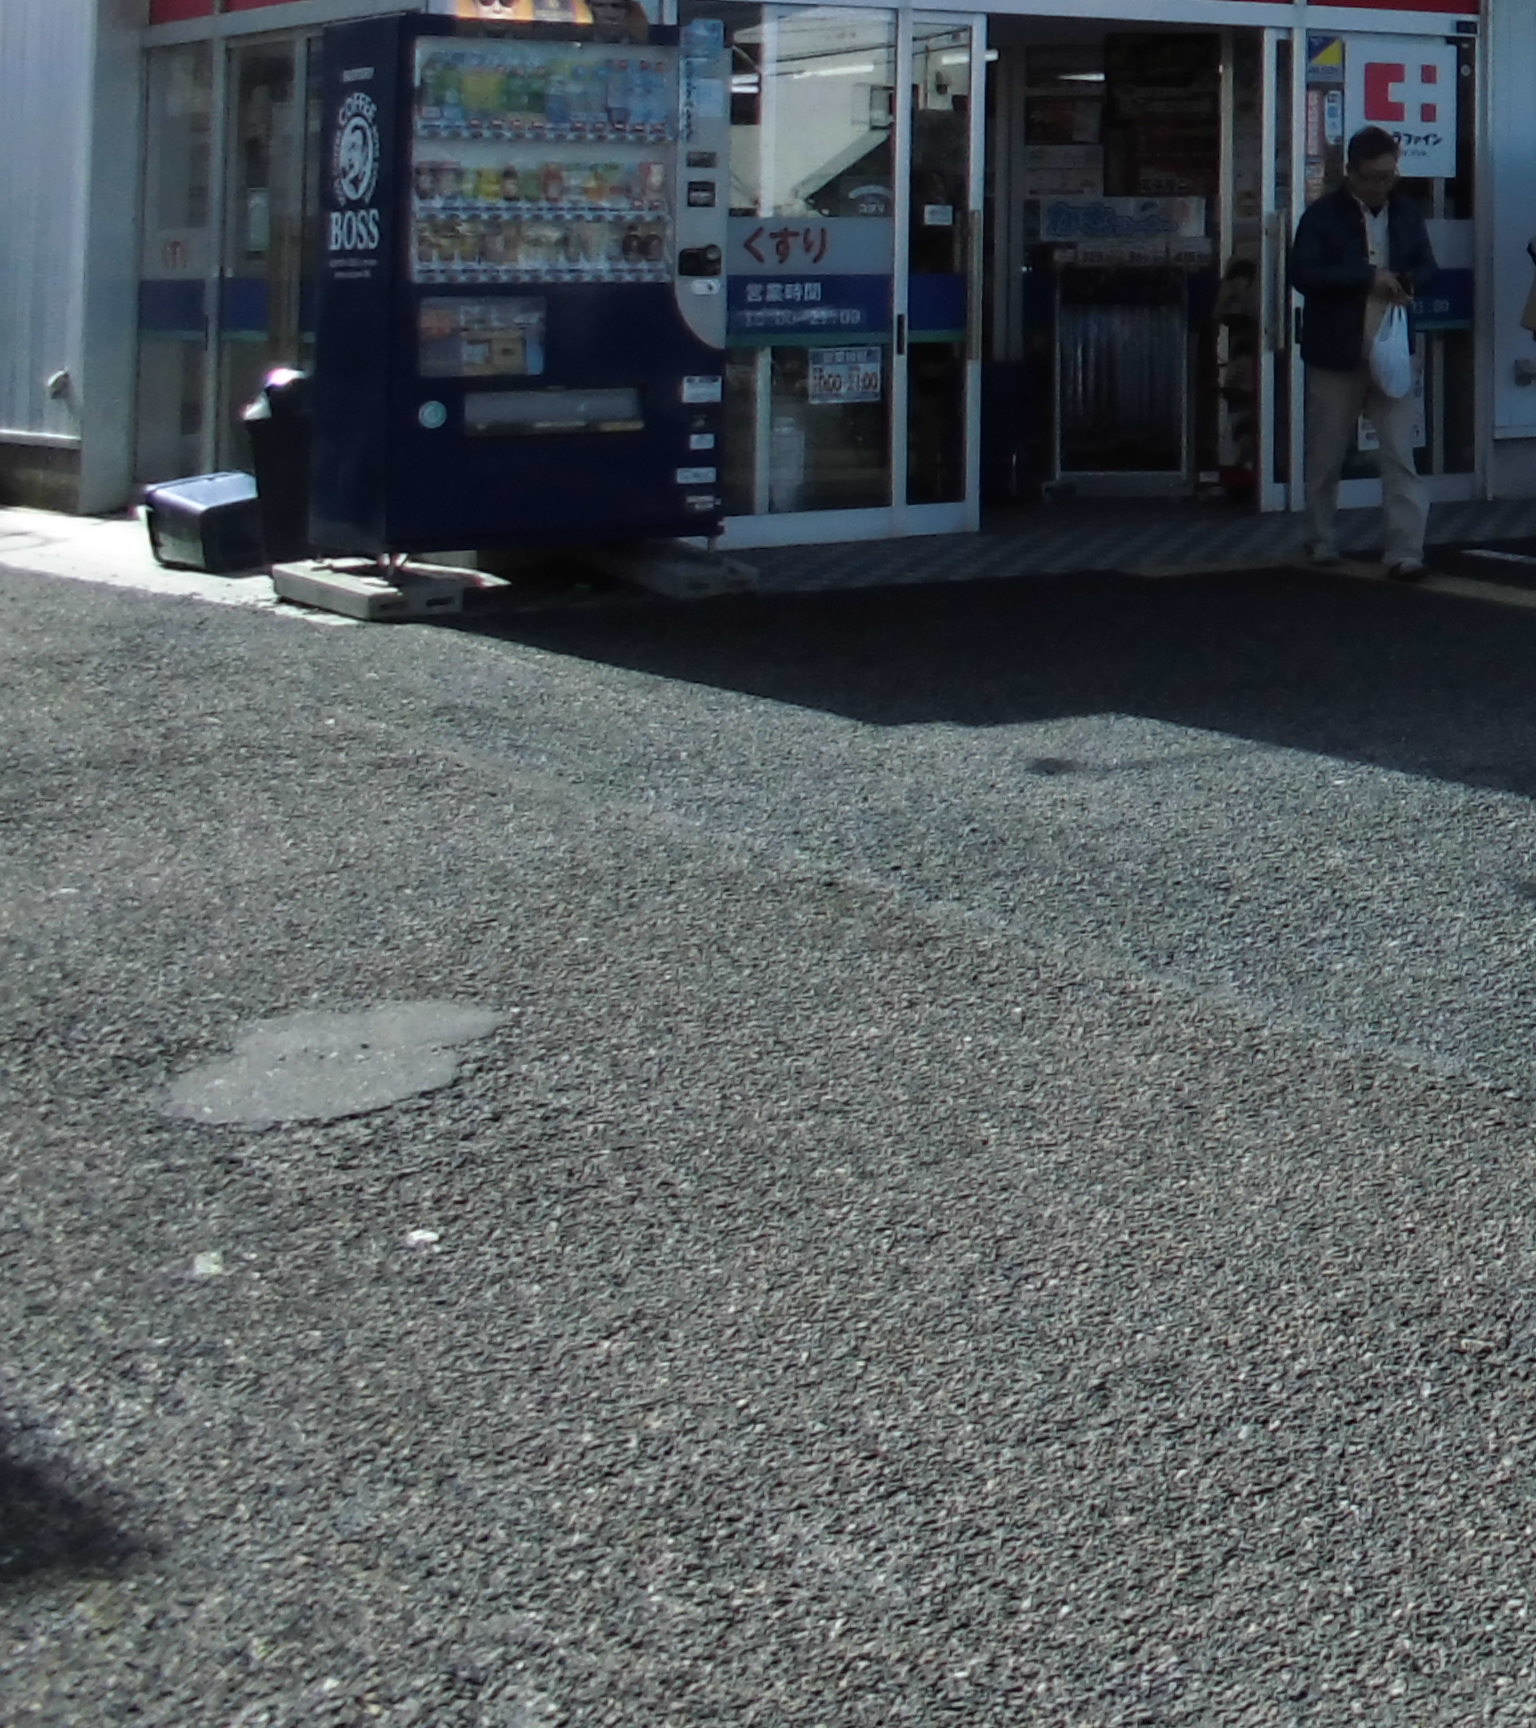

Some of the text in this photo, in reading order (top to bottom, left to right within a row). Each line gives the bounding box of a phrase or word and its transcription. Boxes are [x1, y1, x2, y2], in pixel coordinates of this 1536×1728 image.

[329, 208, 381, 251] BOSS
[743, 226, 827, 263] くすり
